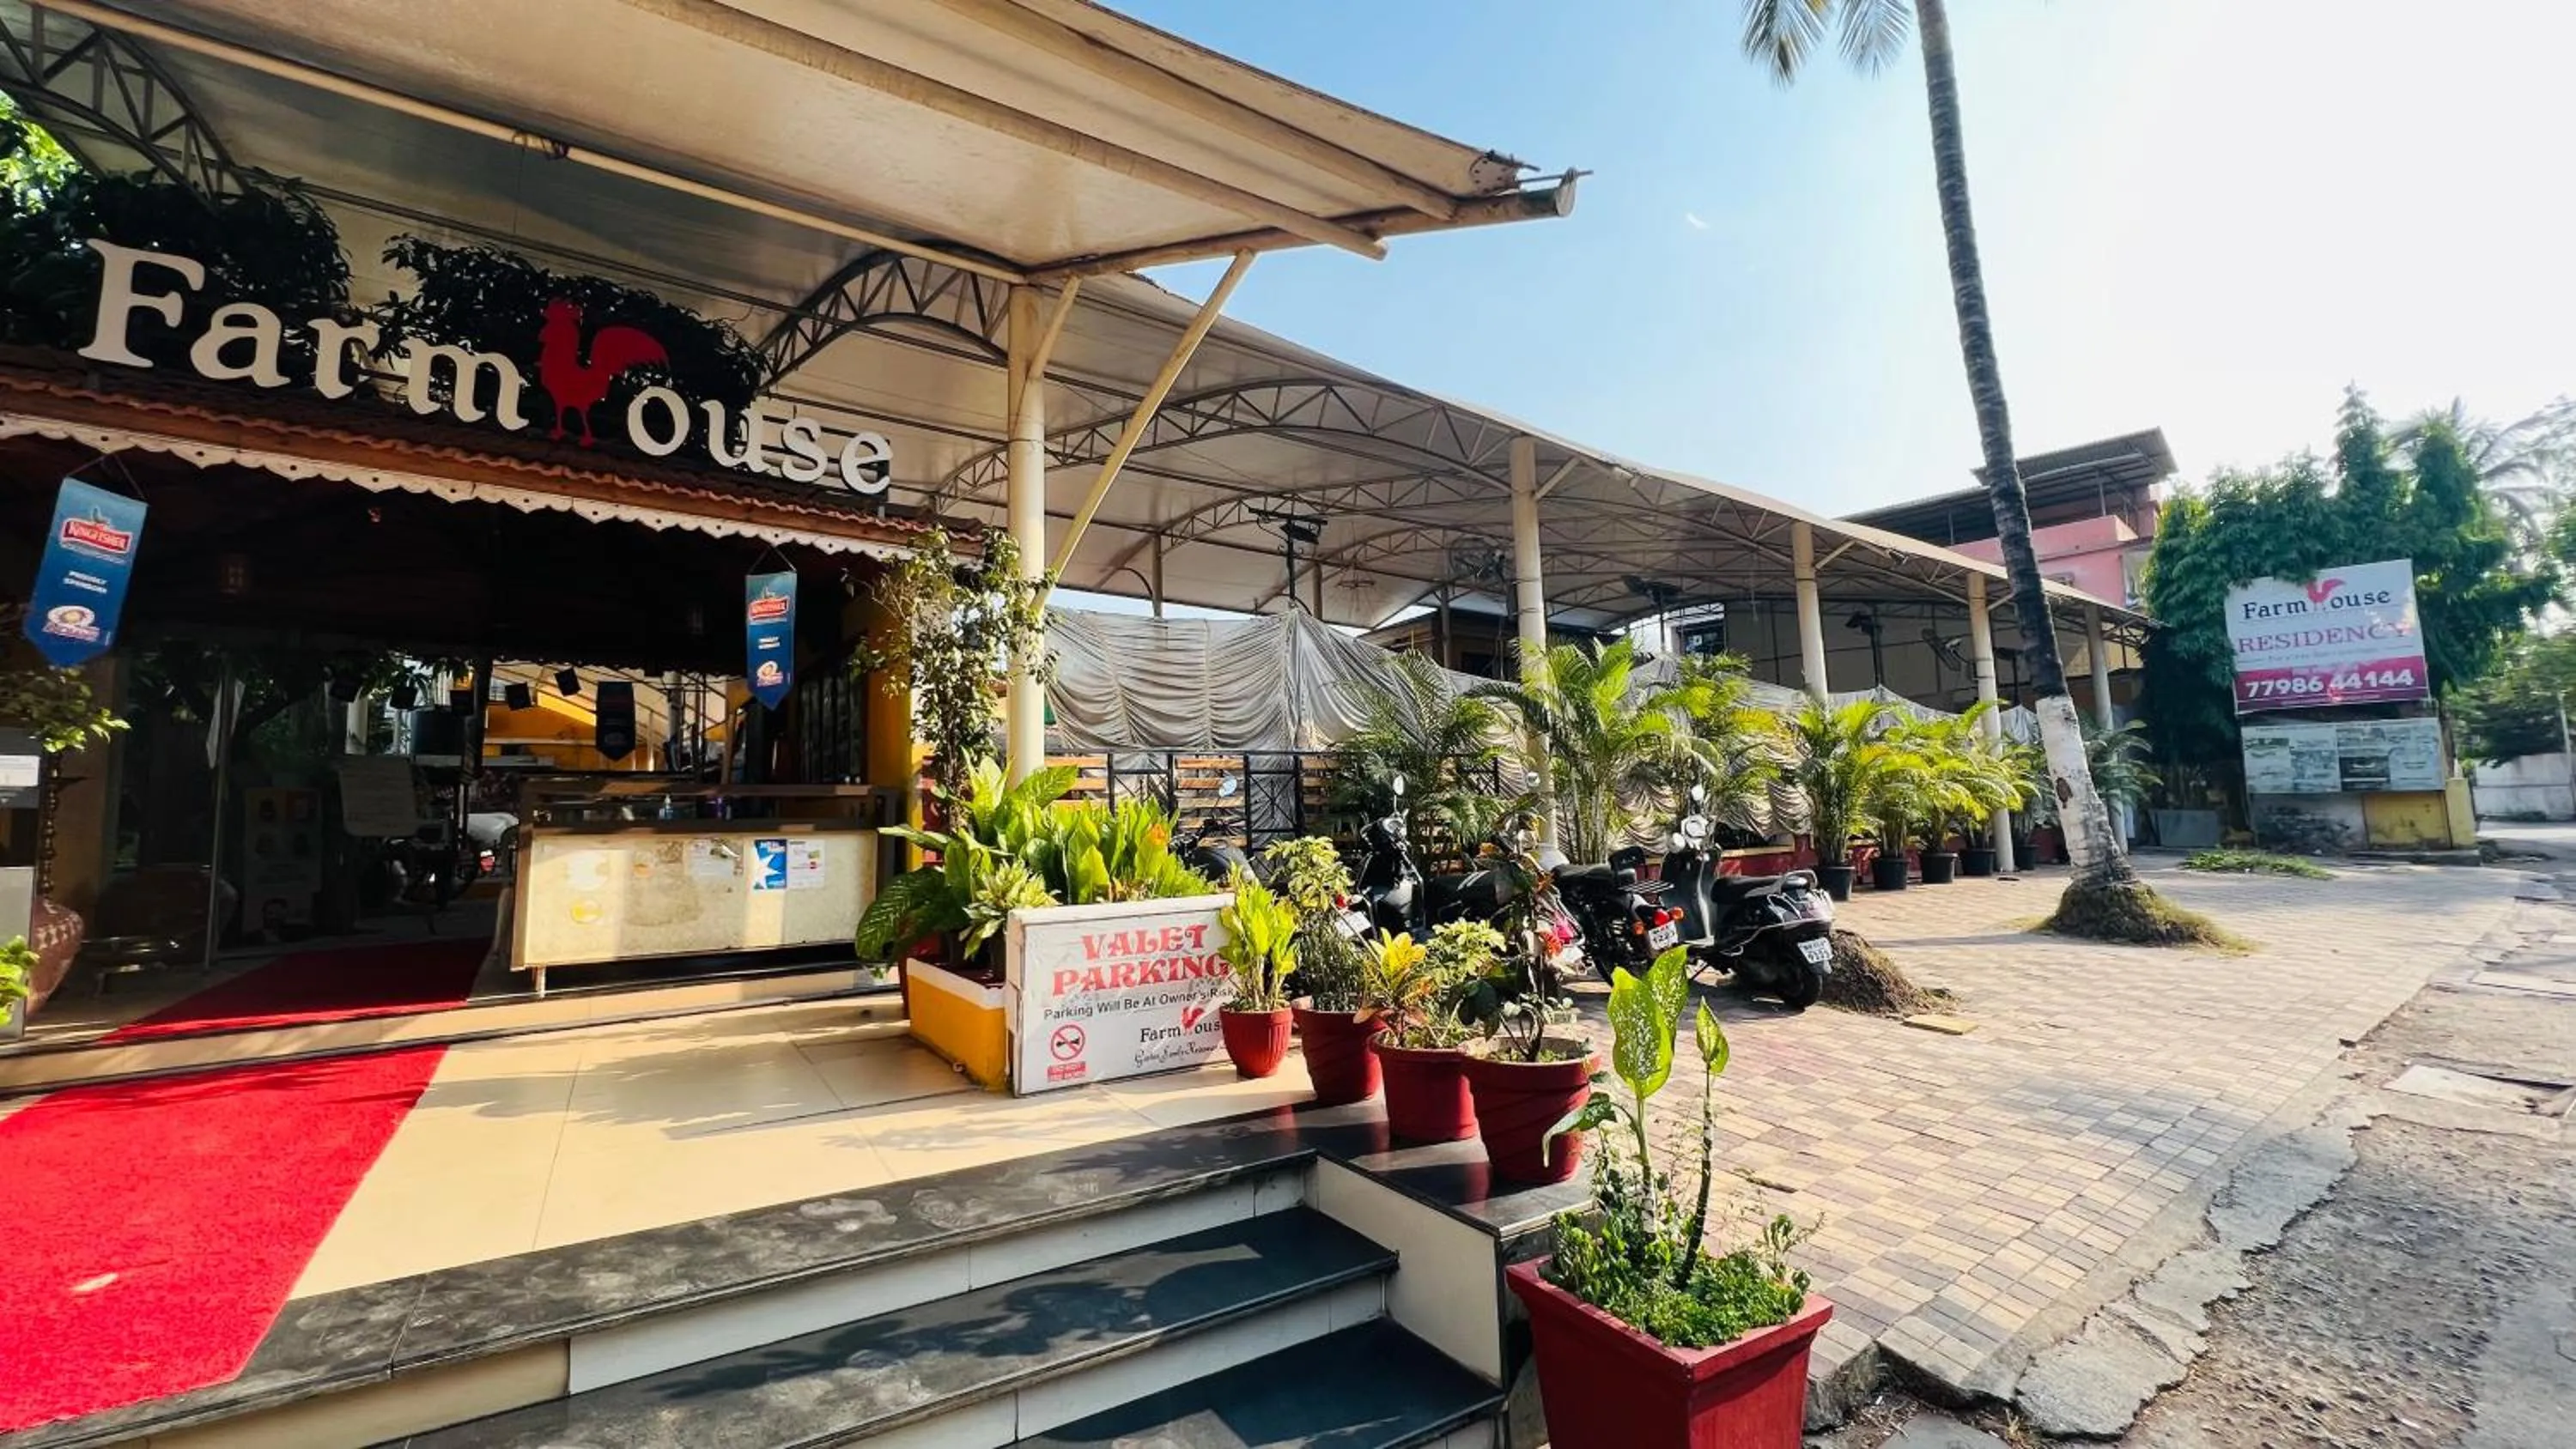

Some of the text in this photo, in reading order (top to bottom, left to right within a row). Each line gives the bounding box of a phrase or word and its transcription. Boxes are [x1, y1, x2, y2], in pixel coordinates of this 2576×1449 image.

[77, 237, 529, 432] Farm
[2242, 597, 2308, 621] Farm
[2238, 622, 2411, 653] RESIDENCY
[2245, 676, 2324, 698] 77986
[2330, 669, 2415, 689] 44144
[1081, 924, 1208, 960] VALET
[1052, 953, 1230, 997] PARKING
[1043, 1003, 1093, 1020] Parking
[1097, 1000, 1121, 1014] Will
[1124, 998, 1140, 1010] Be
[1143, 996, 1156, 1007] At
[1158, 990, 1206, 1005] Owner's
[1139, 1020, 1222, 1043] Farm ous
